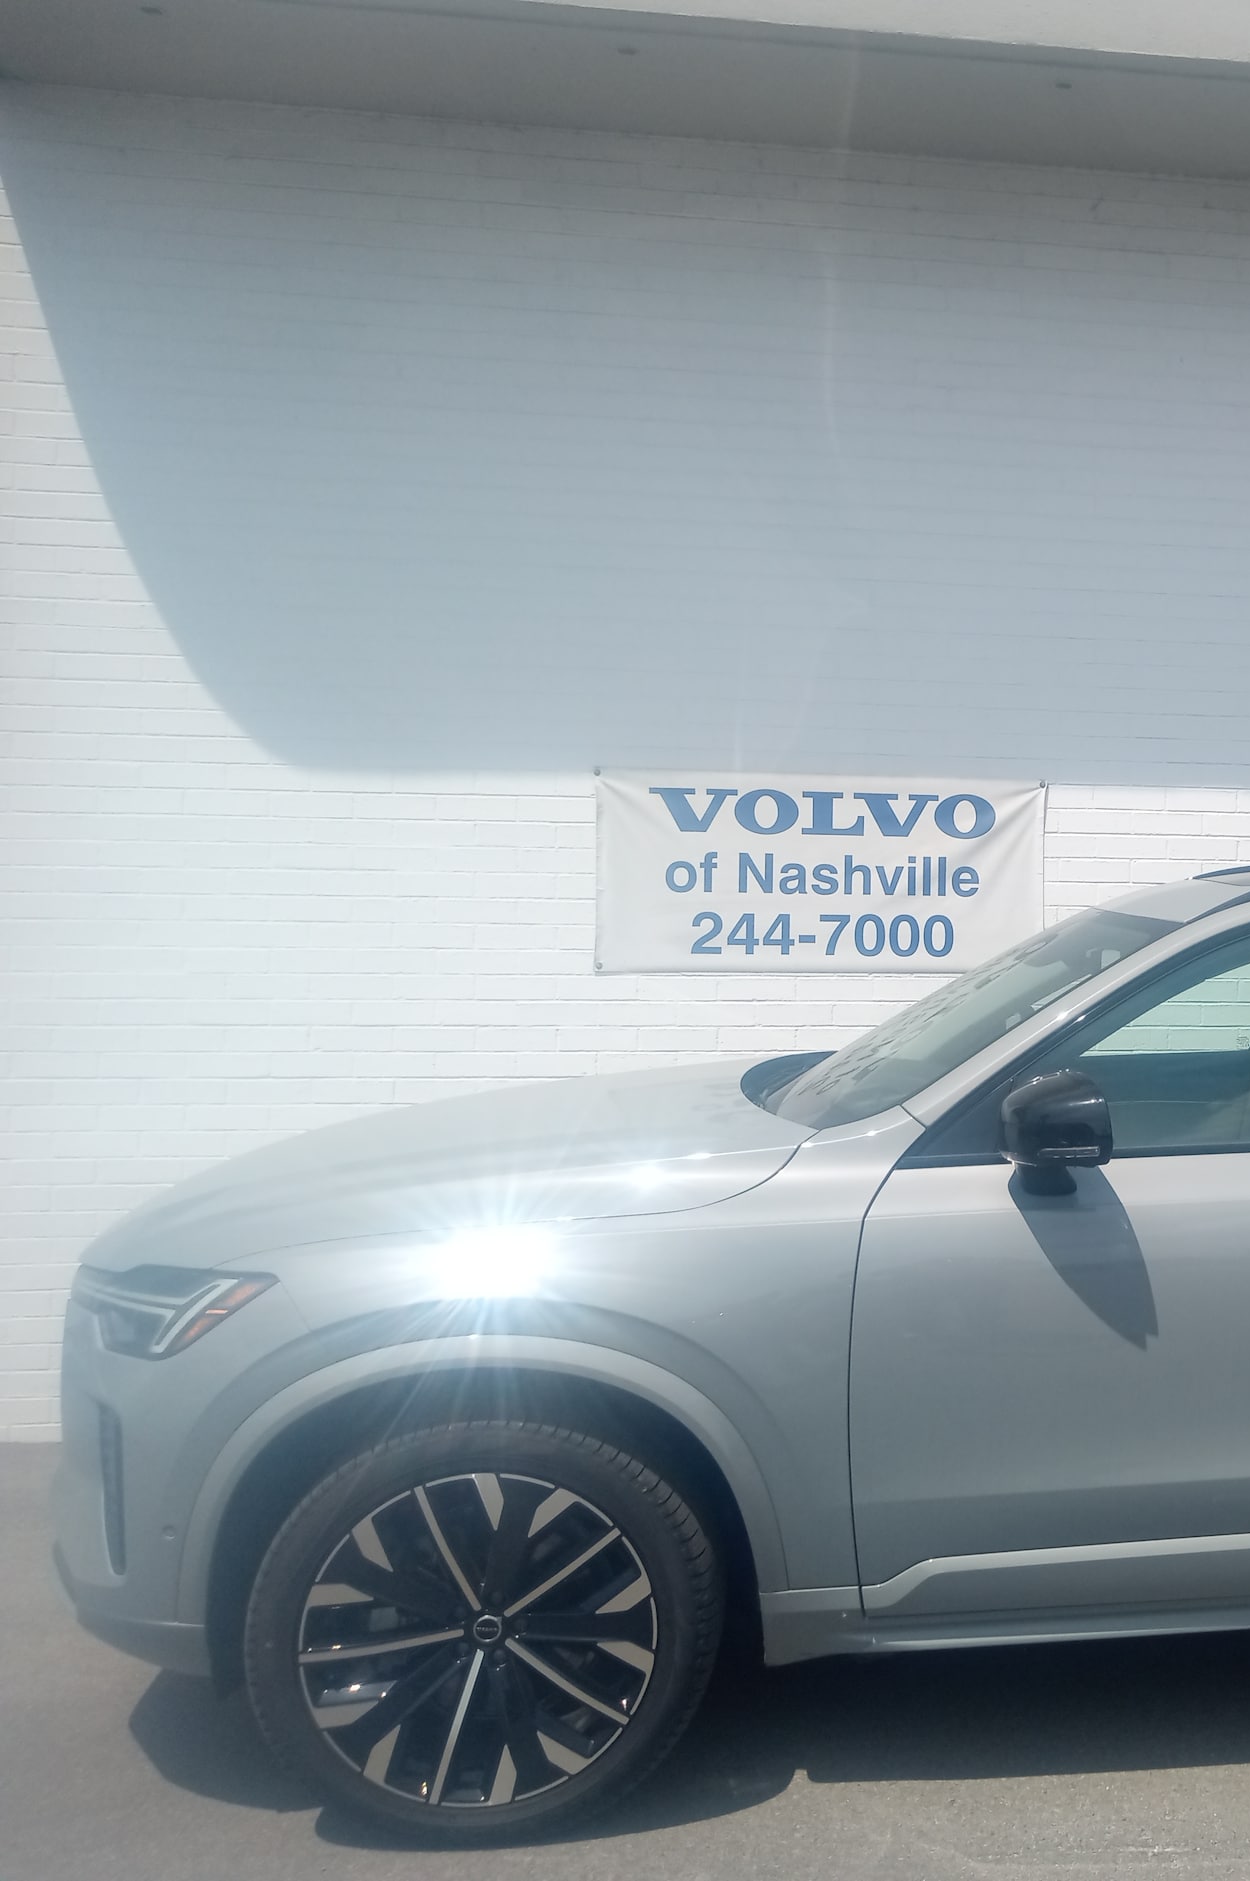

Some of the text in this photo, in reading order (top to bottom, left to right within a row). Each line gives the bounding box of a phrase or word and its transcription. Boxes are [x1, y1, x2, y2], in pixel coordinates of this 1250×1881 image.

[649, 787, 997, 839] VOLVO
[665, 850, 981, 898] of Nashville
[690, 911, 956, 957] 244-7000
